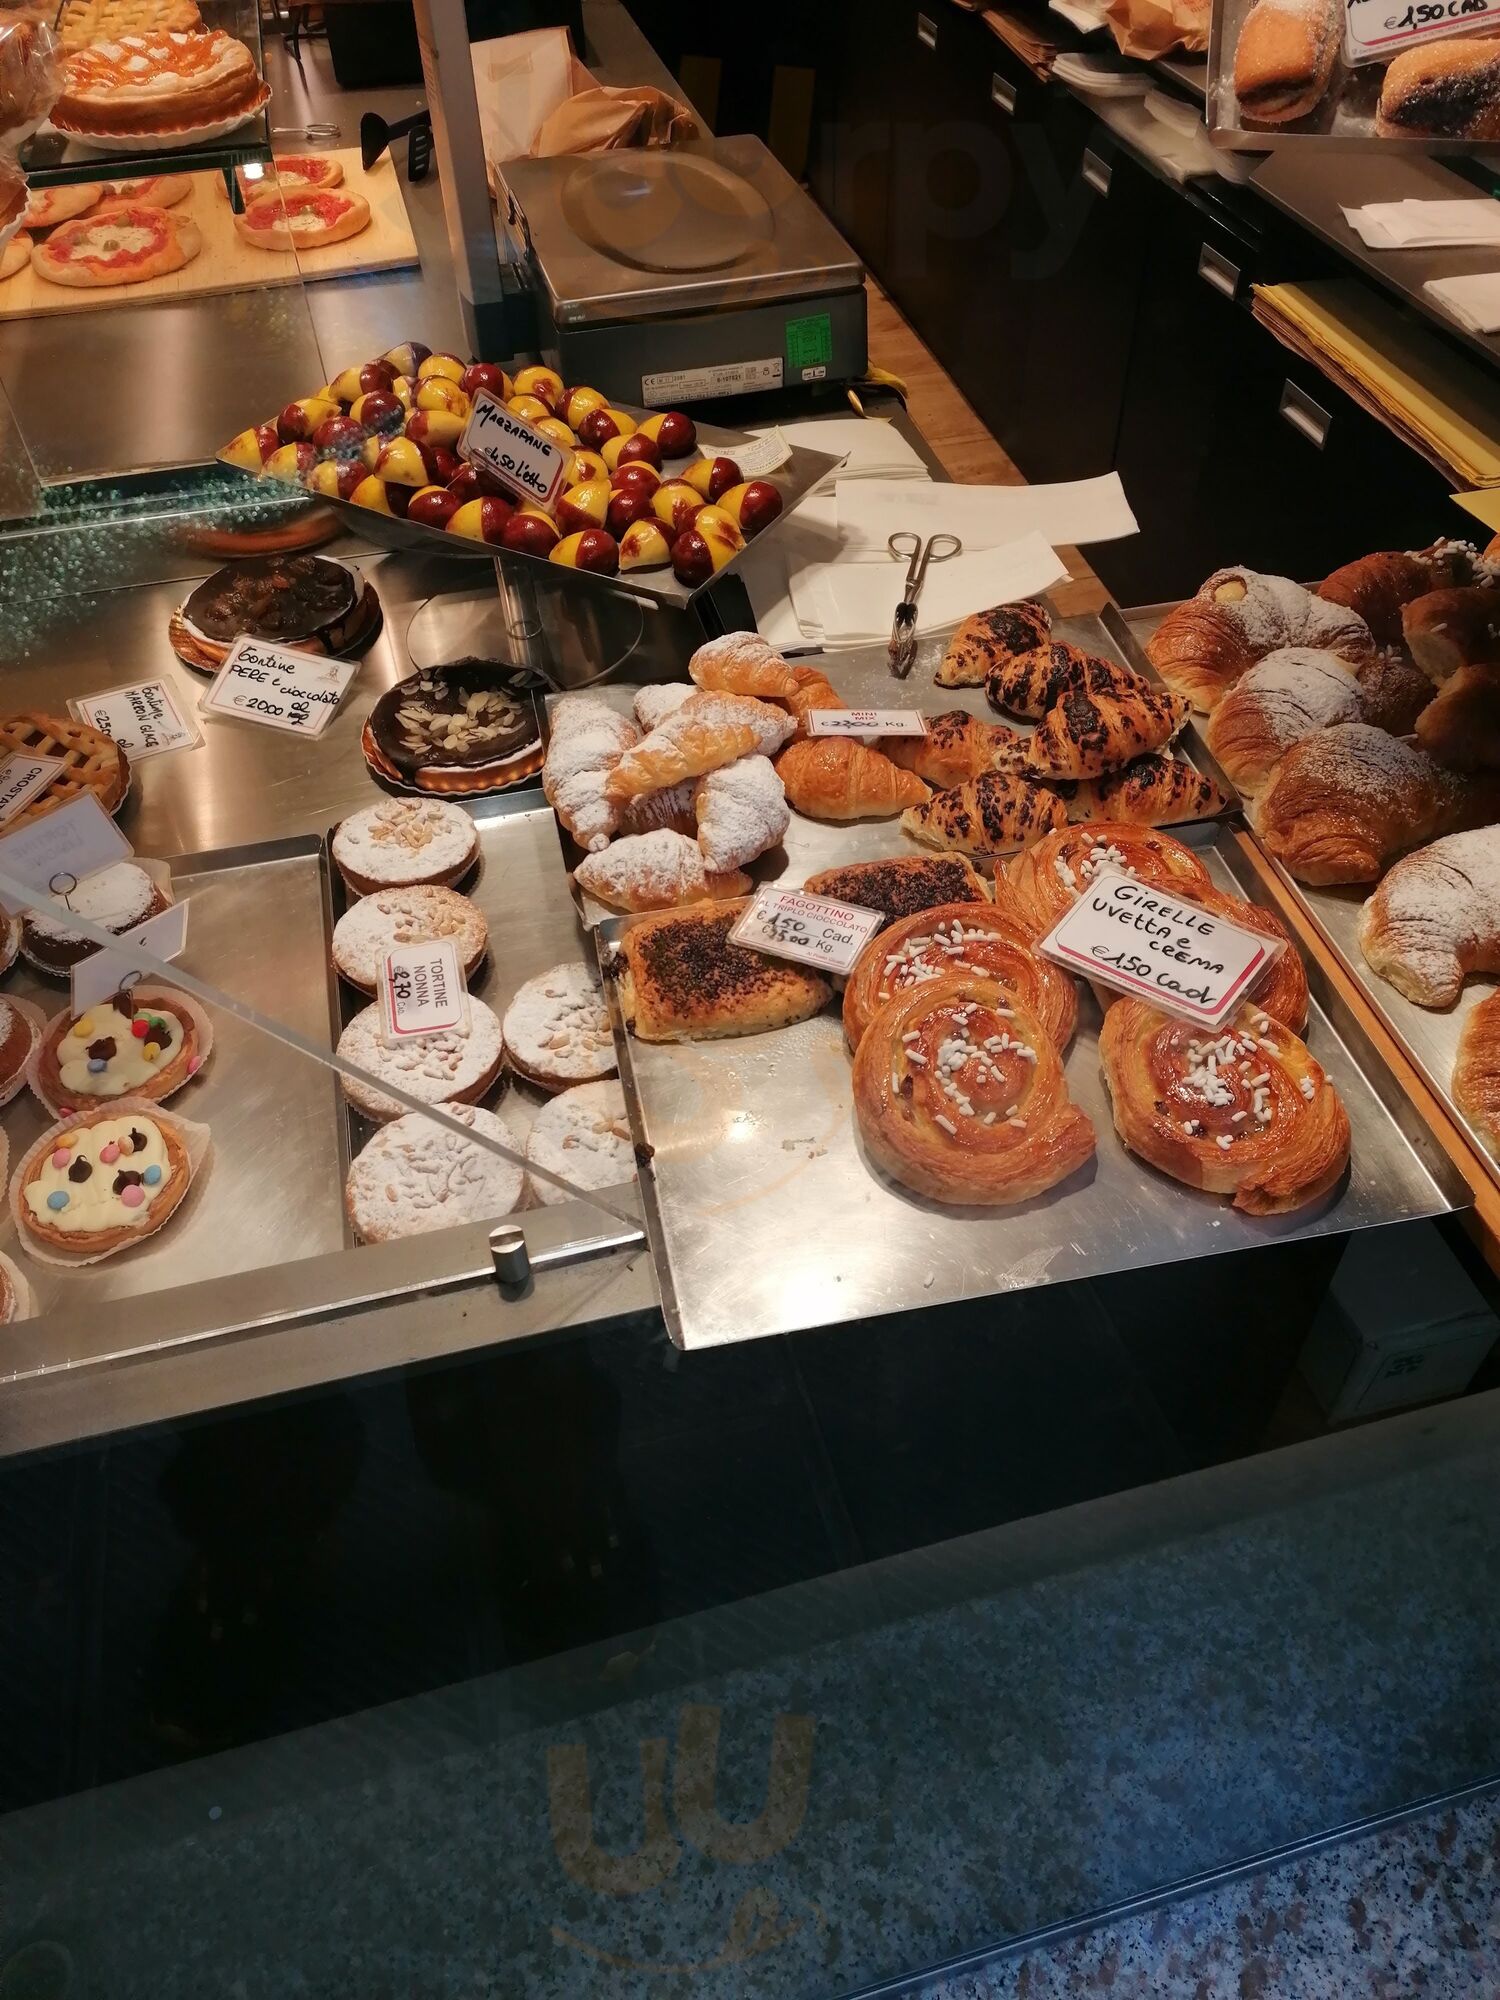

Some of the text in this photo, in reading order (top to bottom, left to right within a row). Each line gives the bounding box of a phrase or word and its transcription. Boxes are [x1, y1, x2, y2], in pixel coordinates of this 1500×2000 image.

[229, 664, 269, 683] PERE
[772, 903, 805, 916] TRIPLO
[806, 913, 868, 933] CIOCCOLATO
[780, 895, 854, 921] FAGOTTINO
[815, 939, 834, 953] Kg.
[822, 928, 854, 946] Cad.
[413, 965, 430, 1007] NONNA
[430, 957, 449, 1009] TORTINE
